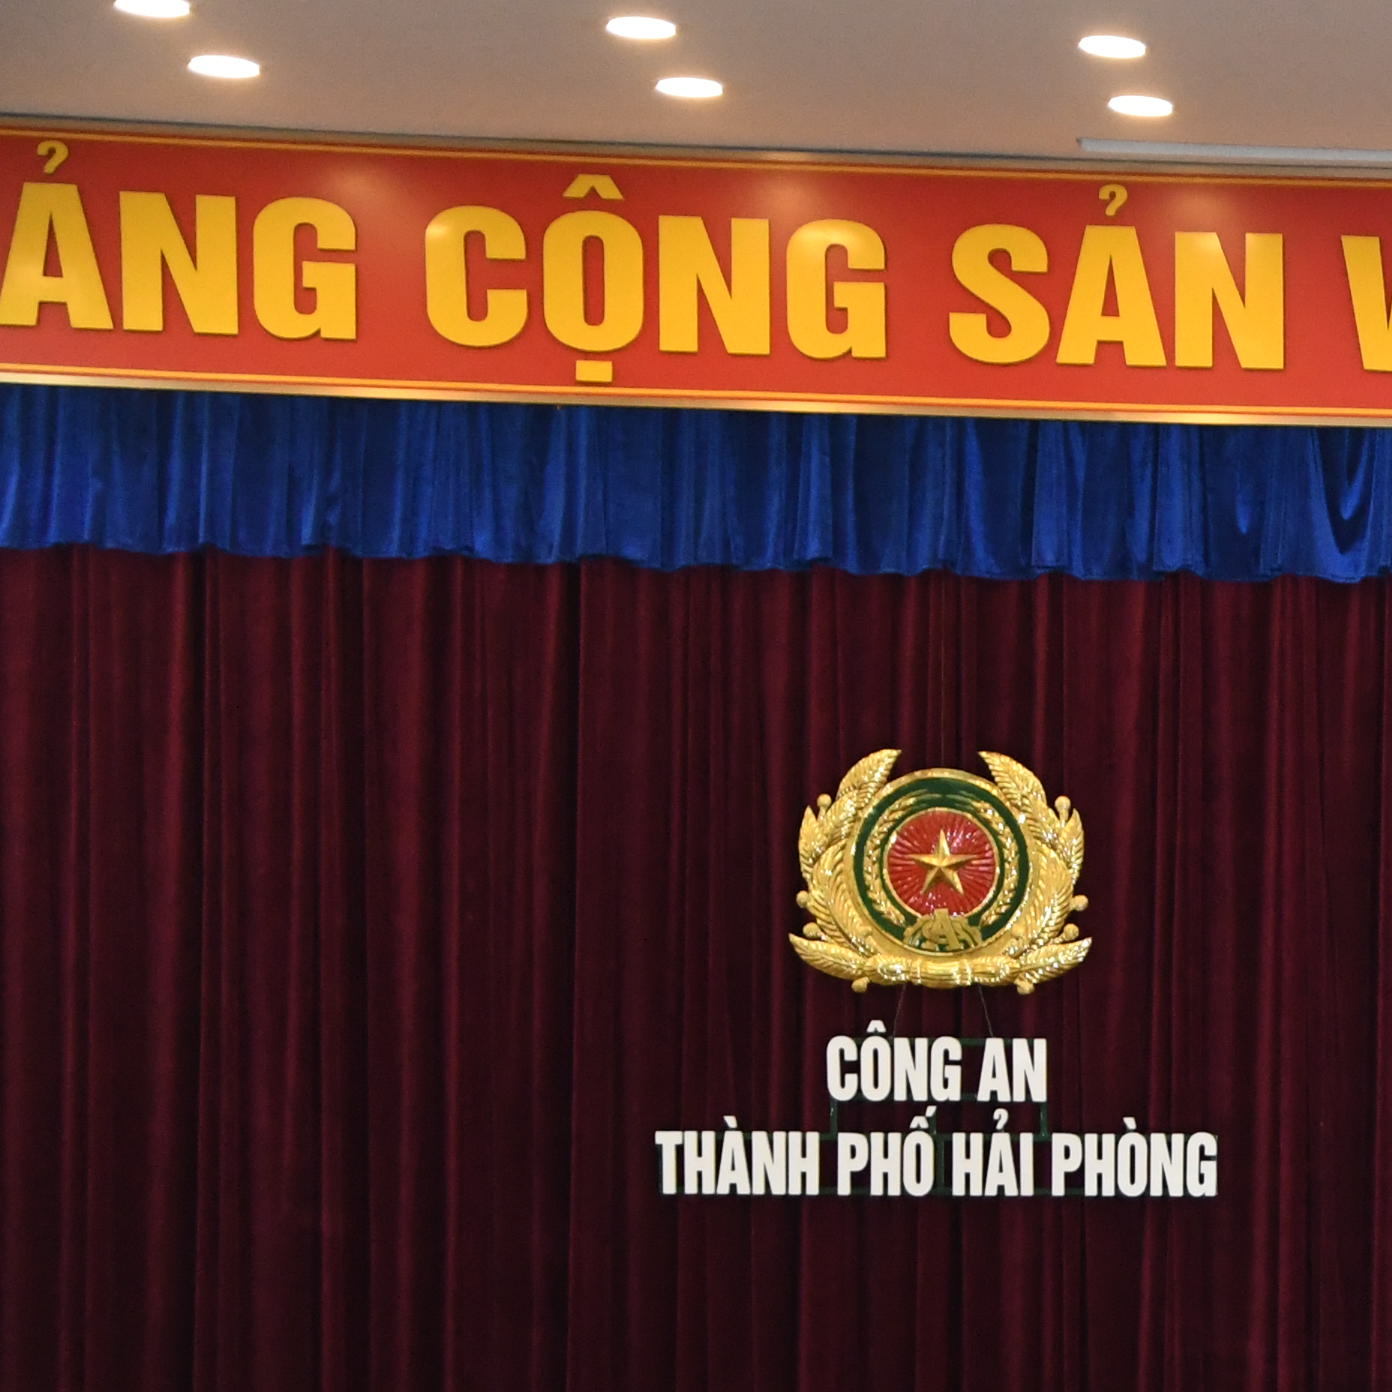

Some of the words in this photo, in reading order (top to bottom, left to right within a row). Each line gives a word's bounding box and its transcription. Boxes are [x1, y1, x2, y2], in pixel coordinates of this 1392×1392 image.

[424, 174, 887, 383] CỘNG
[949, 183, 1285, 370] SẢN
[826, 1019, 962, 1102] CÔNG
[976, 1037, 1048, 1102] AN
[655, 1115, 820, 1196] THÀNH
[837, 1105, 935, 1197] PHỐ
[952, 1107, 1034, 1197] HẢI
[1051, 1117, 1218, 1197] PHÒNG
